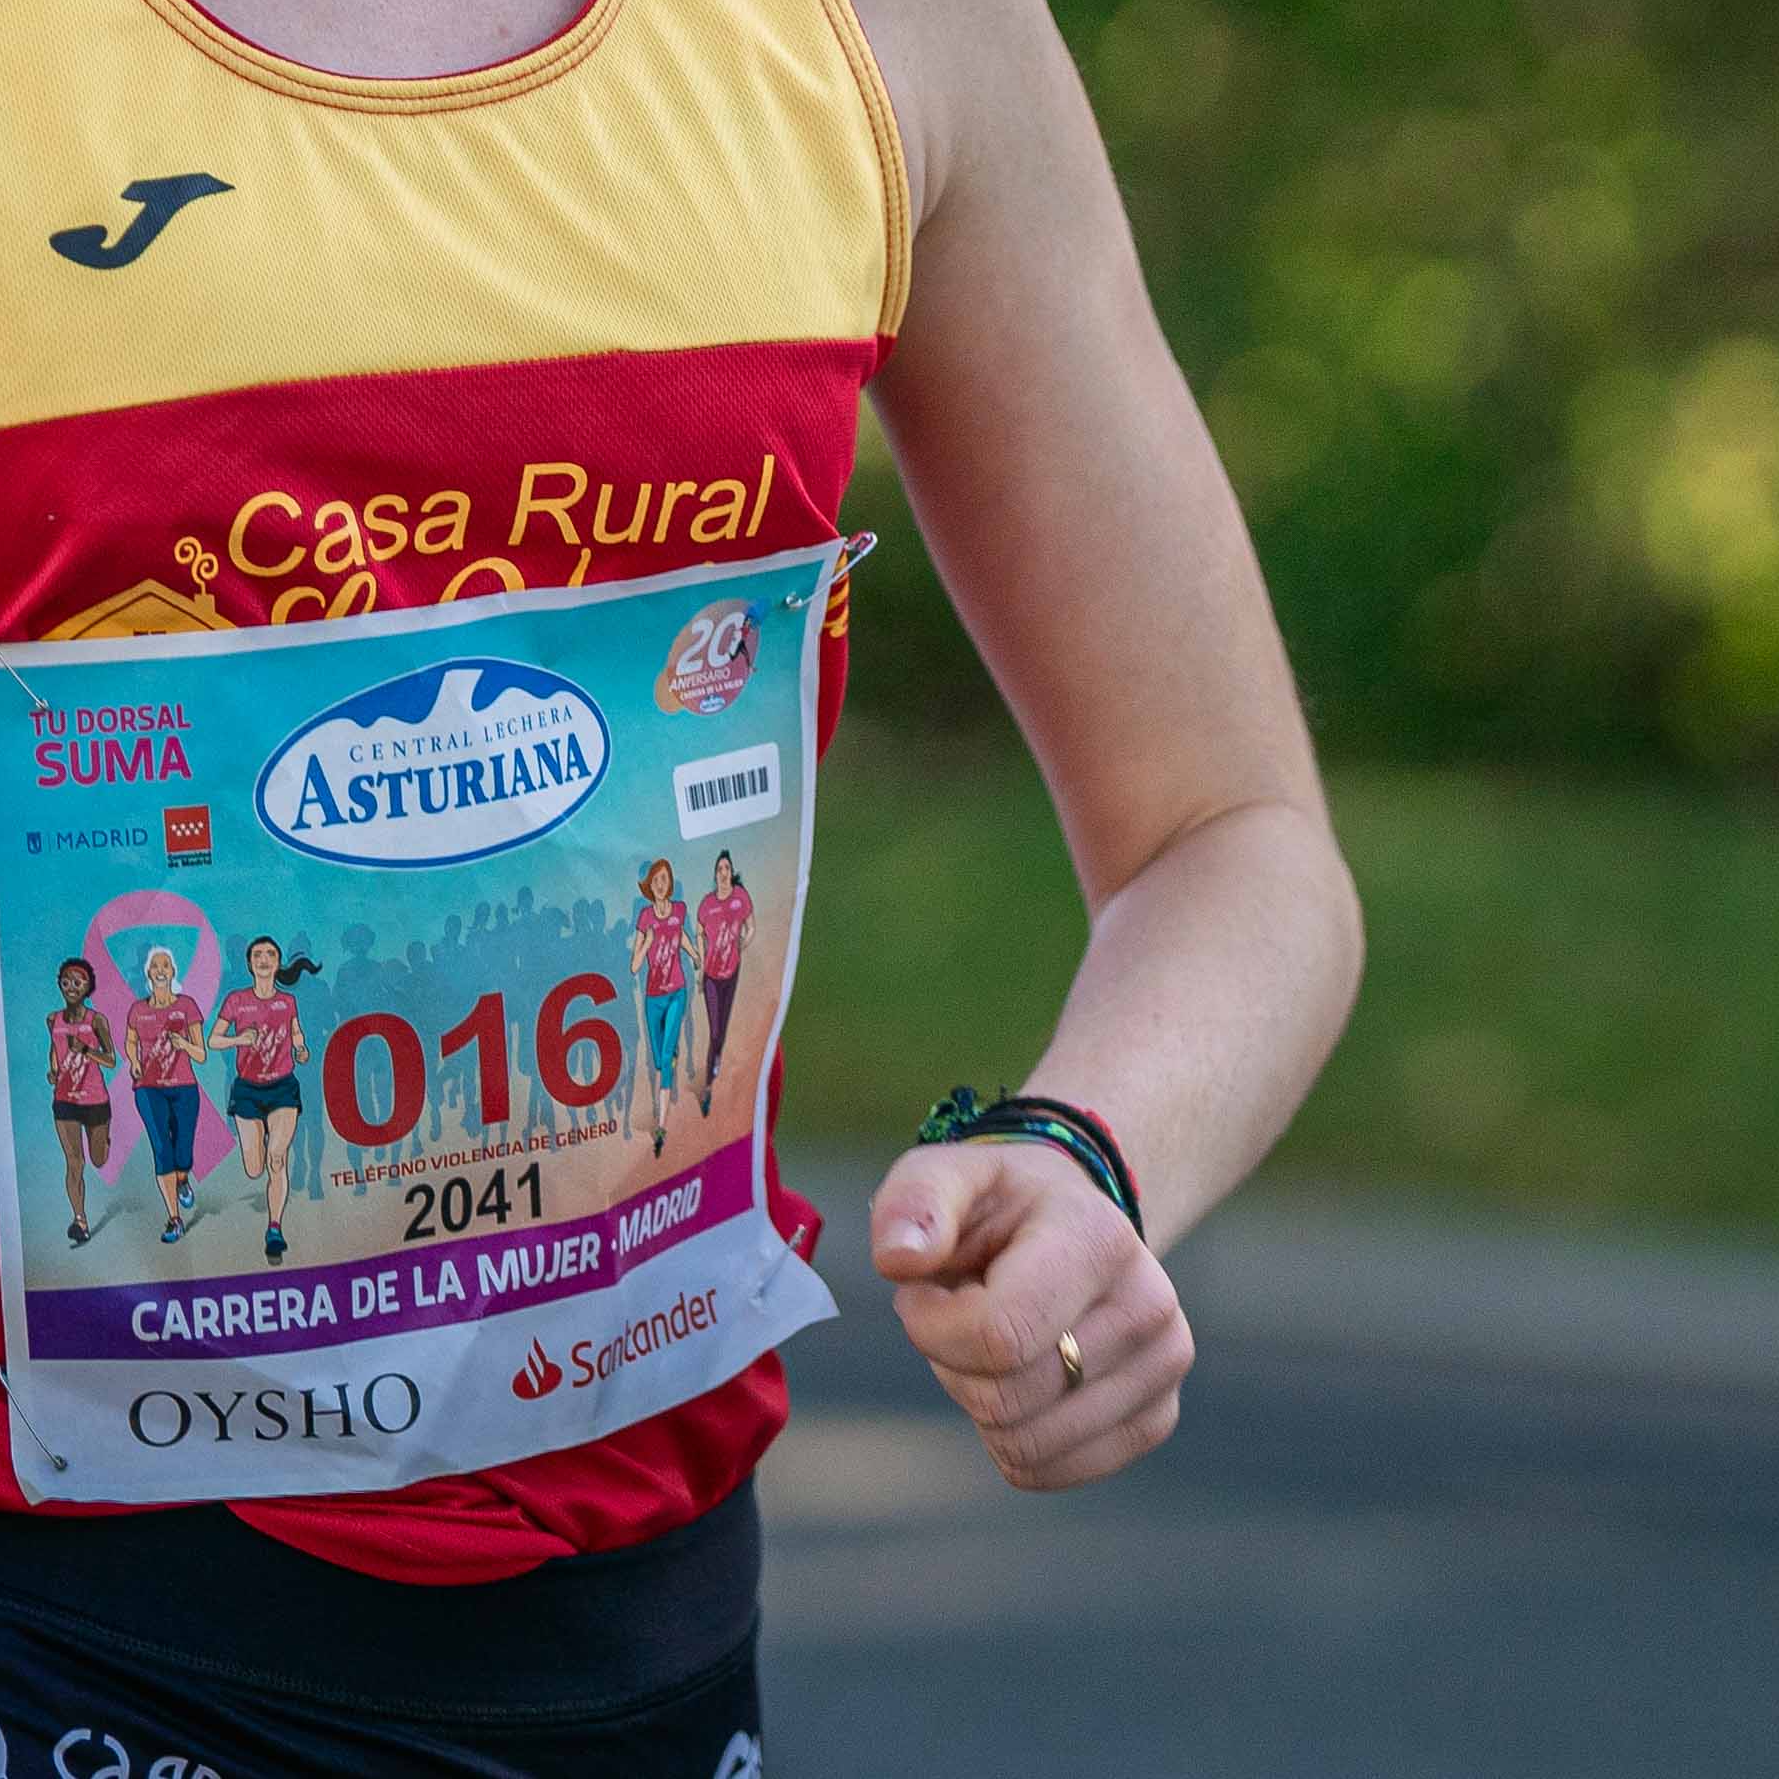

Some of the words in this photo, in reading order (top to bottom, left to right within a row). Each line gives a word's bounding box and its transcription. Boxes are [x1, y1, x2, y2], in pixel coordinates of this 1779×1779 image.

[228, 490, 473, 577] Casa
[508, 454, 774, 545] Rural
[676, 612, 745, 675] 20
[29, 708, 67, 736] TU
[76, 704, 192, 735] DORSAL
[350, 731, 473, 763] CENTRAL
[484, 704, 573, 743] LECHERA
[35, 736, 192, 788] SUMA
[291, 731, 593, 831] ASTURIANA
[57, 828, 149, 850] MADRID
[323, 972, 623, 1147] 016
[330, 1158, 426, 1187] TELÉFONO
[431, 1139, 524, 1171] VIOLENCIA
[528, 1132, 552, 1151] DE
[403, 1162, 542, 1242] 2041
[132, 1283, 338, 1343] CARRERA
[351, 1269, 400, 1320] DE
[414, 1260, 466, 1308] LA
[477, 1231, 600, 1297] MUJER
[571, 1288, 718, 1389] Santander
[128, 1372, 422, 1447] OYSHO
